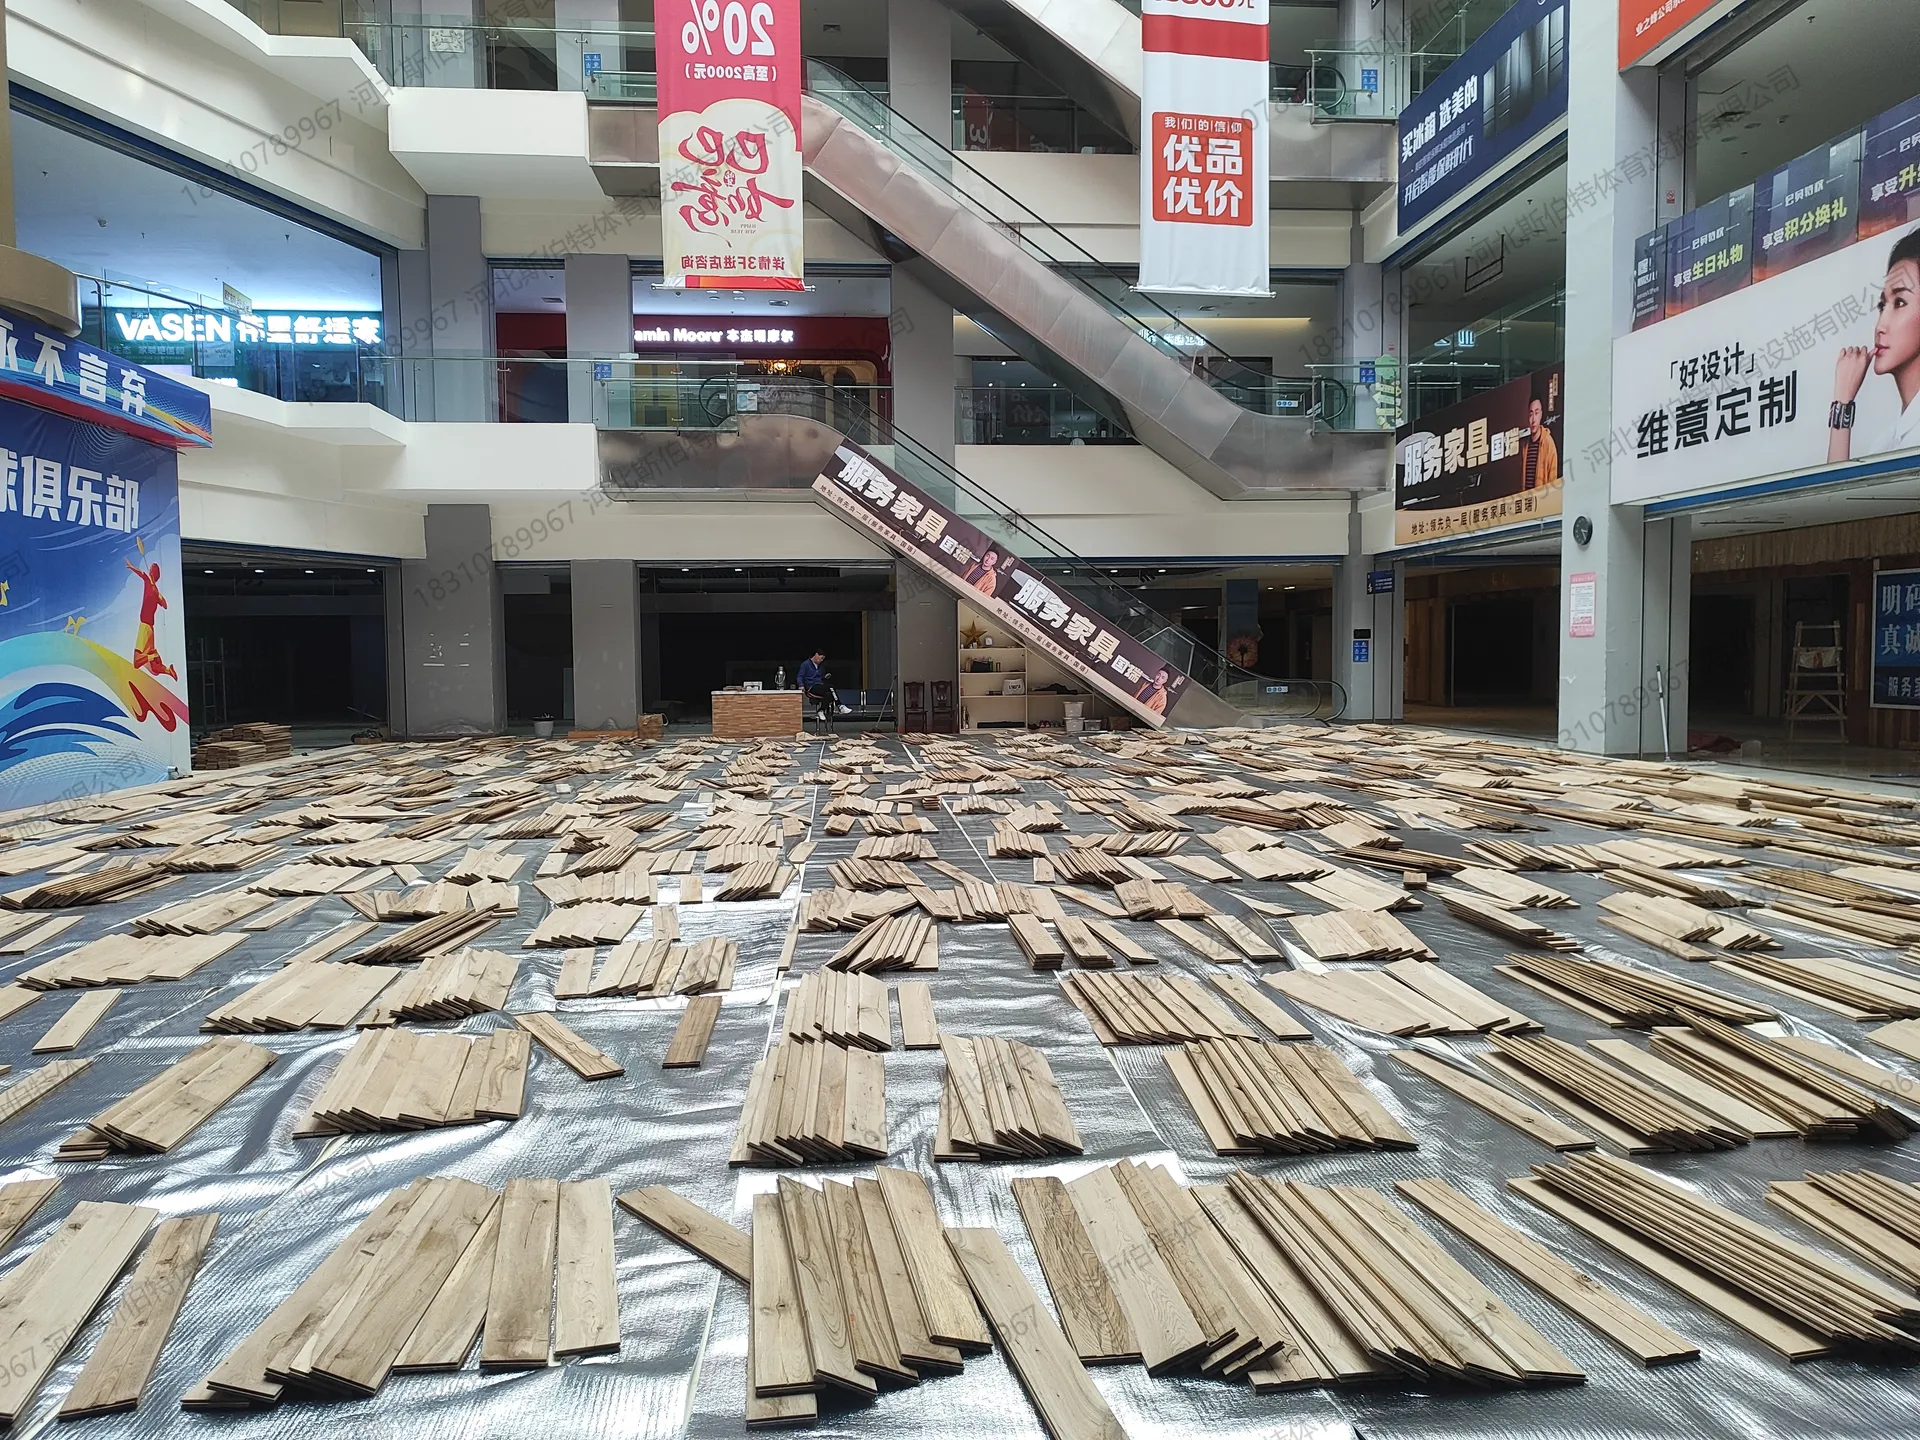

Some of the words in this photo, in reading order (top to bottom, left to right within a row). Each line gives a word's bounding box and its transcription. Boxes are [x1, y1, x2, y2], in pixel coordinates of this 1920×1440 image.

[1402, 110, 1436, 163] 买冰箱
[1439, 74, 1478, 132] 选美的
[1163, 134, 1243, 175] 优品
[1404, 134, 1475, 206] 开启智能保鲜时代
[1163, 176, 1243, 218] 优价
[1762, 197, 1848, 250] 享受积分换礼
[1673, 244, 1743, 288] 享受生日礼物
[115, 313, 231, 342] VASEN
[1637, 370, 1797, 459] 维意定制
[1404, 418, 1489, 488] 服务家具
[1491, 427, 1521, 462] 国瑞
[838, 455, 949, 544] 服务家具
[938, 535, 973, 565] 国瑞
[1013, 577, 1121, 665] 服务家具
[1110, 654, 1143, 684] 国瑞
